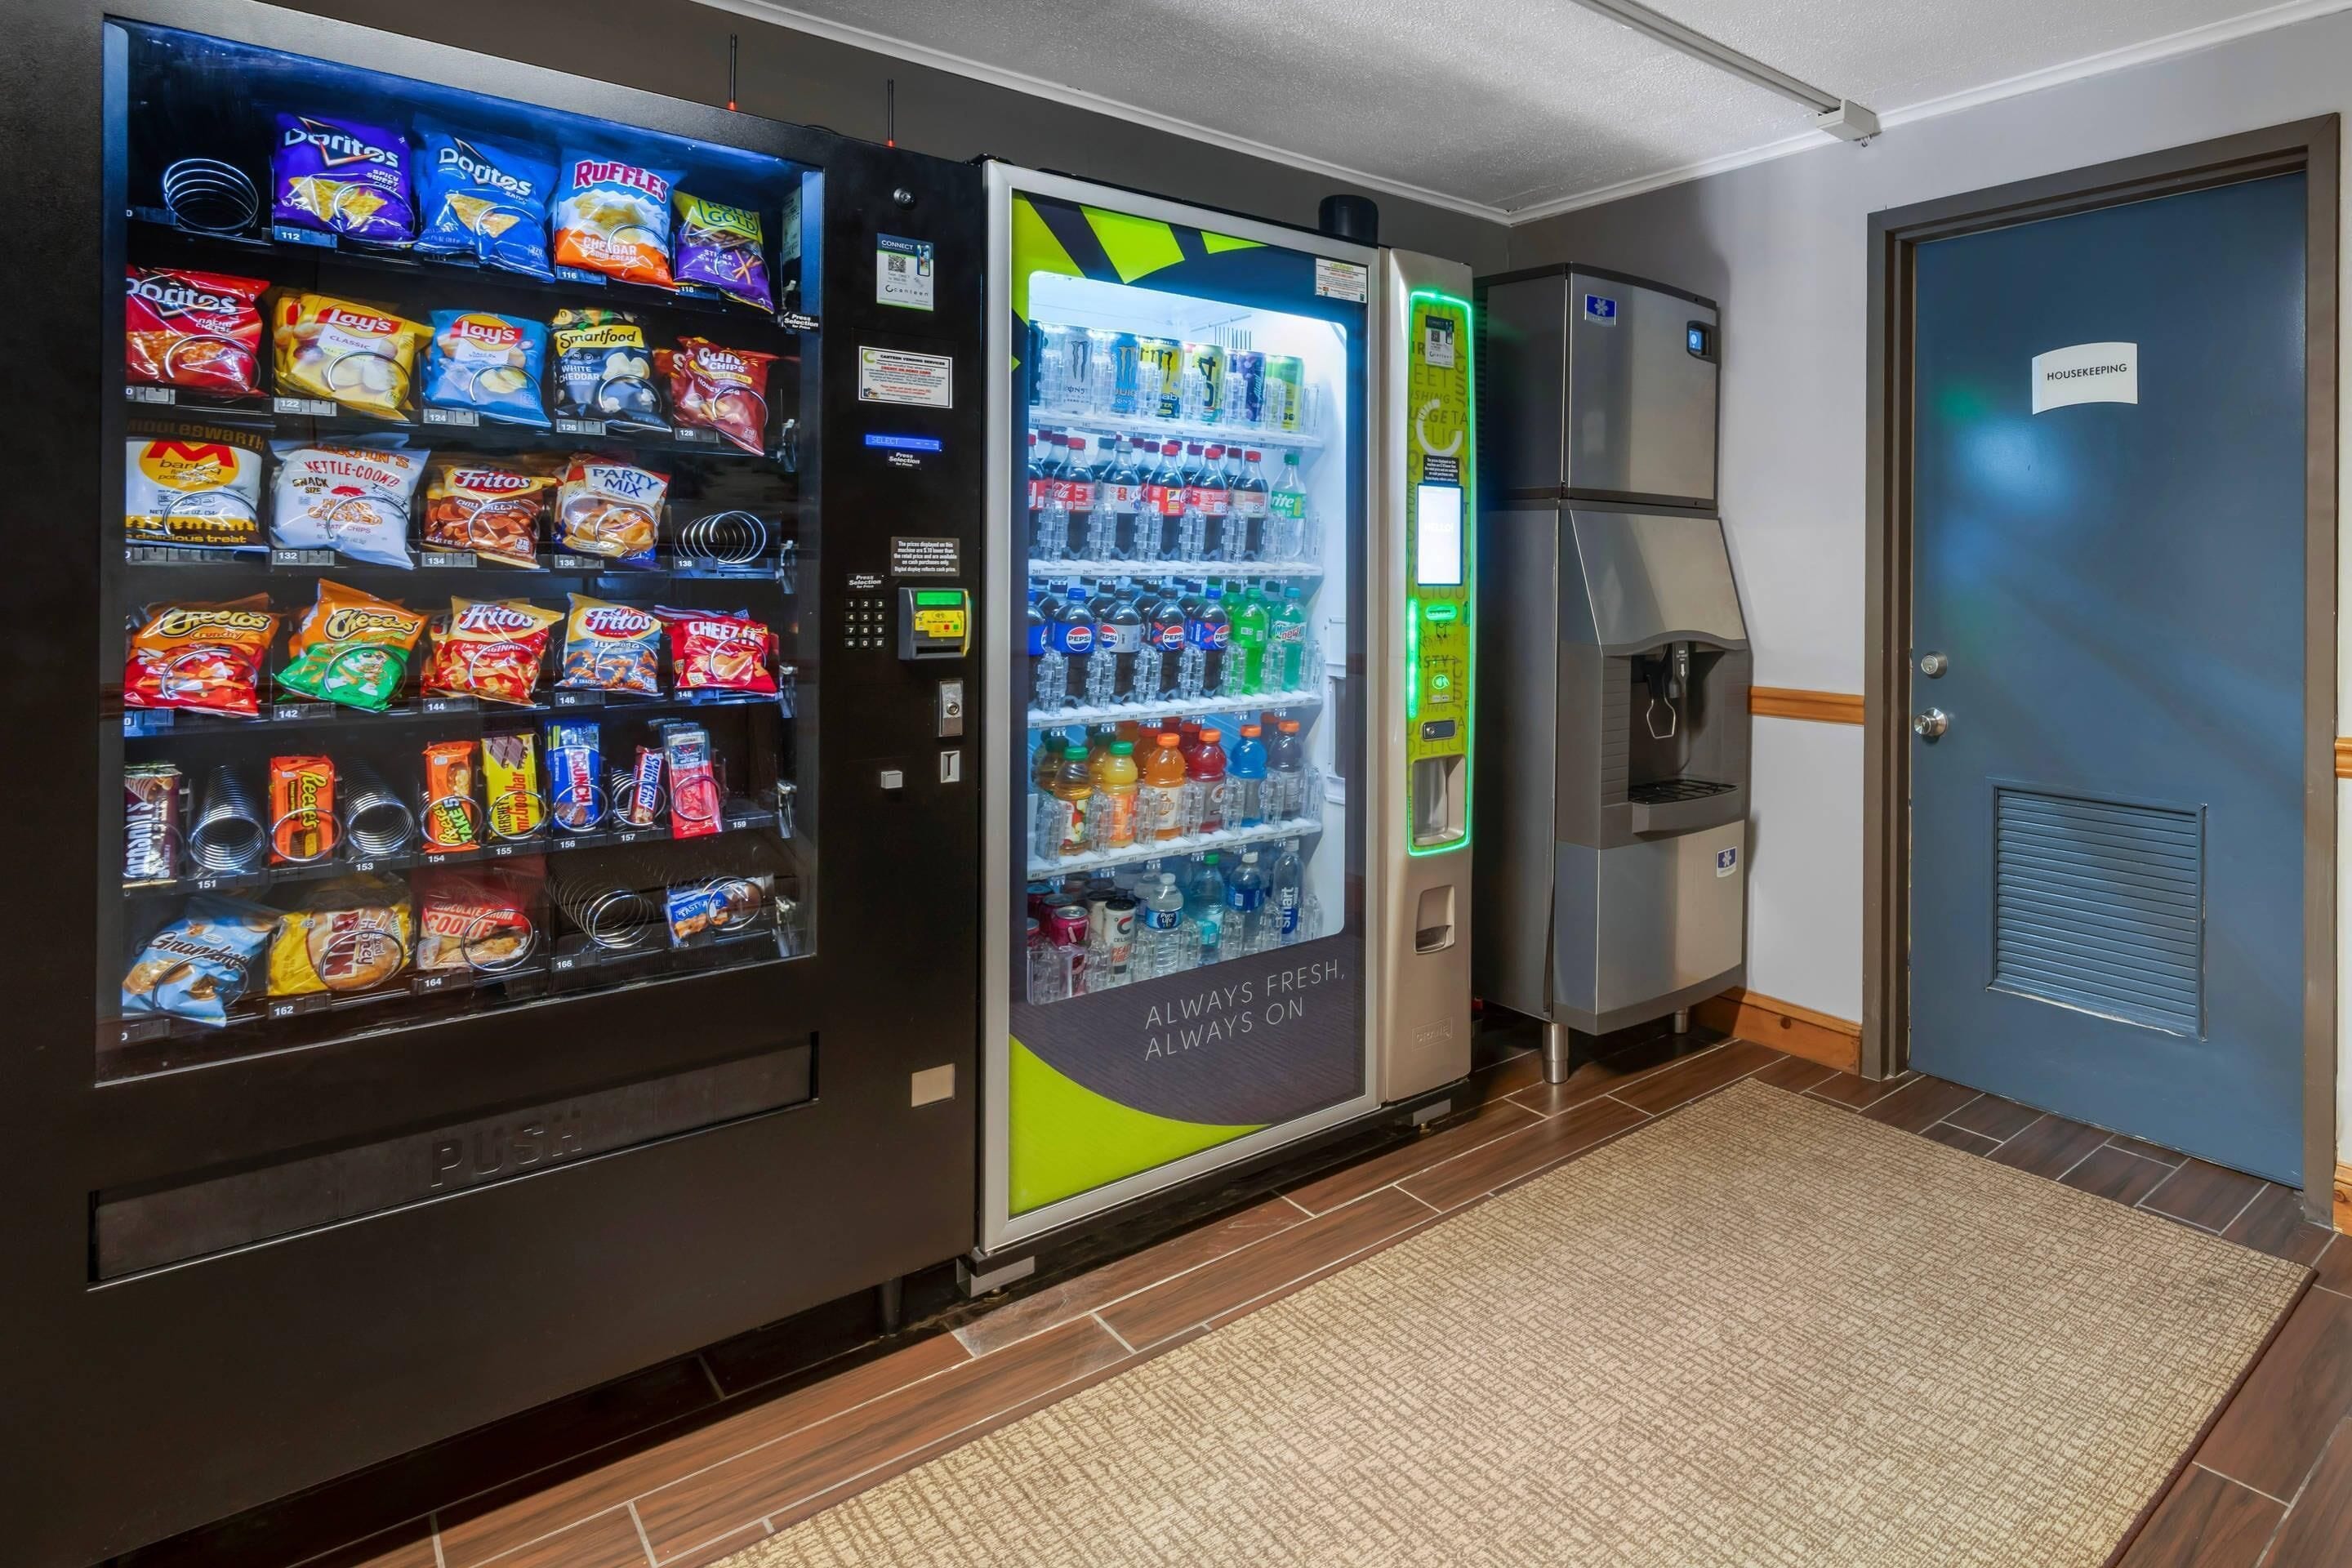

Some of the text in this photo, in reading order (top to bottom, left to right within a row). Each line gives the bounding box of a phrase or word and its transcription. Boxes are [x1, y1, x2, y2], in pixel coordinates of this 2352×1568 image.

[284, 127, 399, 167] Doritos
[439, 148, 532, 195] Doritos
[573, 160, 668, 204] RUFFLES
[708, 211, 755, 232] GOLD
[282, 232, 301, 240] 112
[881, 239, 913, 250] CONNECT
[562, 271, 577, 279] 116
[893, 287, 929, 297] canteen
[327, 308, 393, 332] Lay's
[784, 318, 819, 327] Selection
[461, 320, 519, 345] Lay's
[559, 327, 635, 350] Smartfood
[329, 336, 371, 350] CLASSIC
[698, 347, 741, 366] Sun
[561, 364, 592, 372] WHITE
[709, 362, 745, 372] CHIPS
[2047, 363, 2127, 381] HOUSEKEEPING
[559, 372, 599, 383] CHEDDAR
[279, 399, 299, 408] 122
[430, 413, 446, 422] 124
[871, 436, 898, 445] SELECT
[889, 456, 920, 465] Selection
[292, 476, 330, 488] SNACK
[453, 470, 531, 488] Fritos
[592, 468, 658, 491] PARTY
[604, 479, 642, 497] MIX
[136, 533, 247, 543] delicious treat
[278, 552, 297, 560] 132
[160, 608, 270, 637] Cheetos
[459, 604, 535, 630] Fritos
[585, 607, 654, 631] Fritos
[326, 608, 420, 641] Cheetos
[190, 630, 243, 640] Crunchy
[278, 710, 298, 719] 142
[572, 751, 590, 806] CRUNCH
[639, 754, 661, 810] SNICKERS
[443, 798, 473, 842] TAKE 5
[733, 820, 746, 828] 159
[621, 834, 635, 842] 157
[496, 847, 512, 855] 155
[428, 854, 445, 862] 154
[354, 862, 374, 871] 153
[197, 880, 217, 889] 151
[431, 901, 483, 917] CHOCOLATE
[1281, 886, 1294, 929] smart
[428, 914, 493, 939] COOKIE
[1160, 916, 1173, 925] Life
[556, 959, 572, 968] 166
[424, 978, 442, 987] 164
[1145, 959, 1345, 1030] ALWAYS FRESH,
[274, 1006, 294, 1016] 162
[1145, 996, 1303, 1062] ALWAYS ON
[430, 1111, 582, 1187] PUSH
